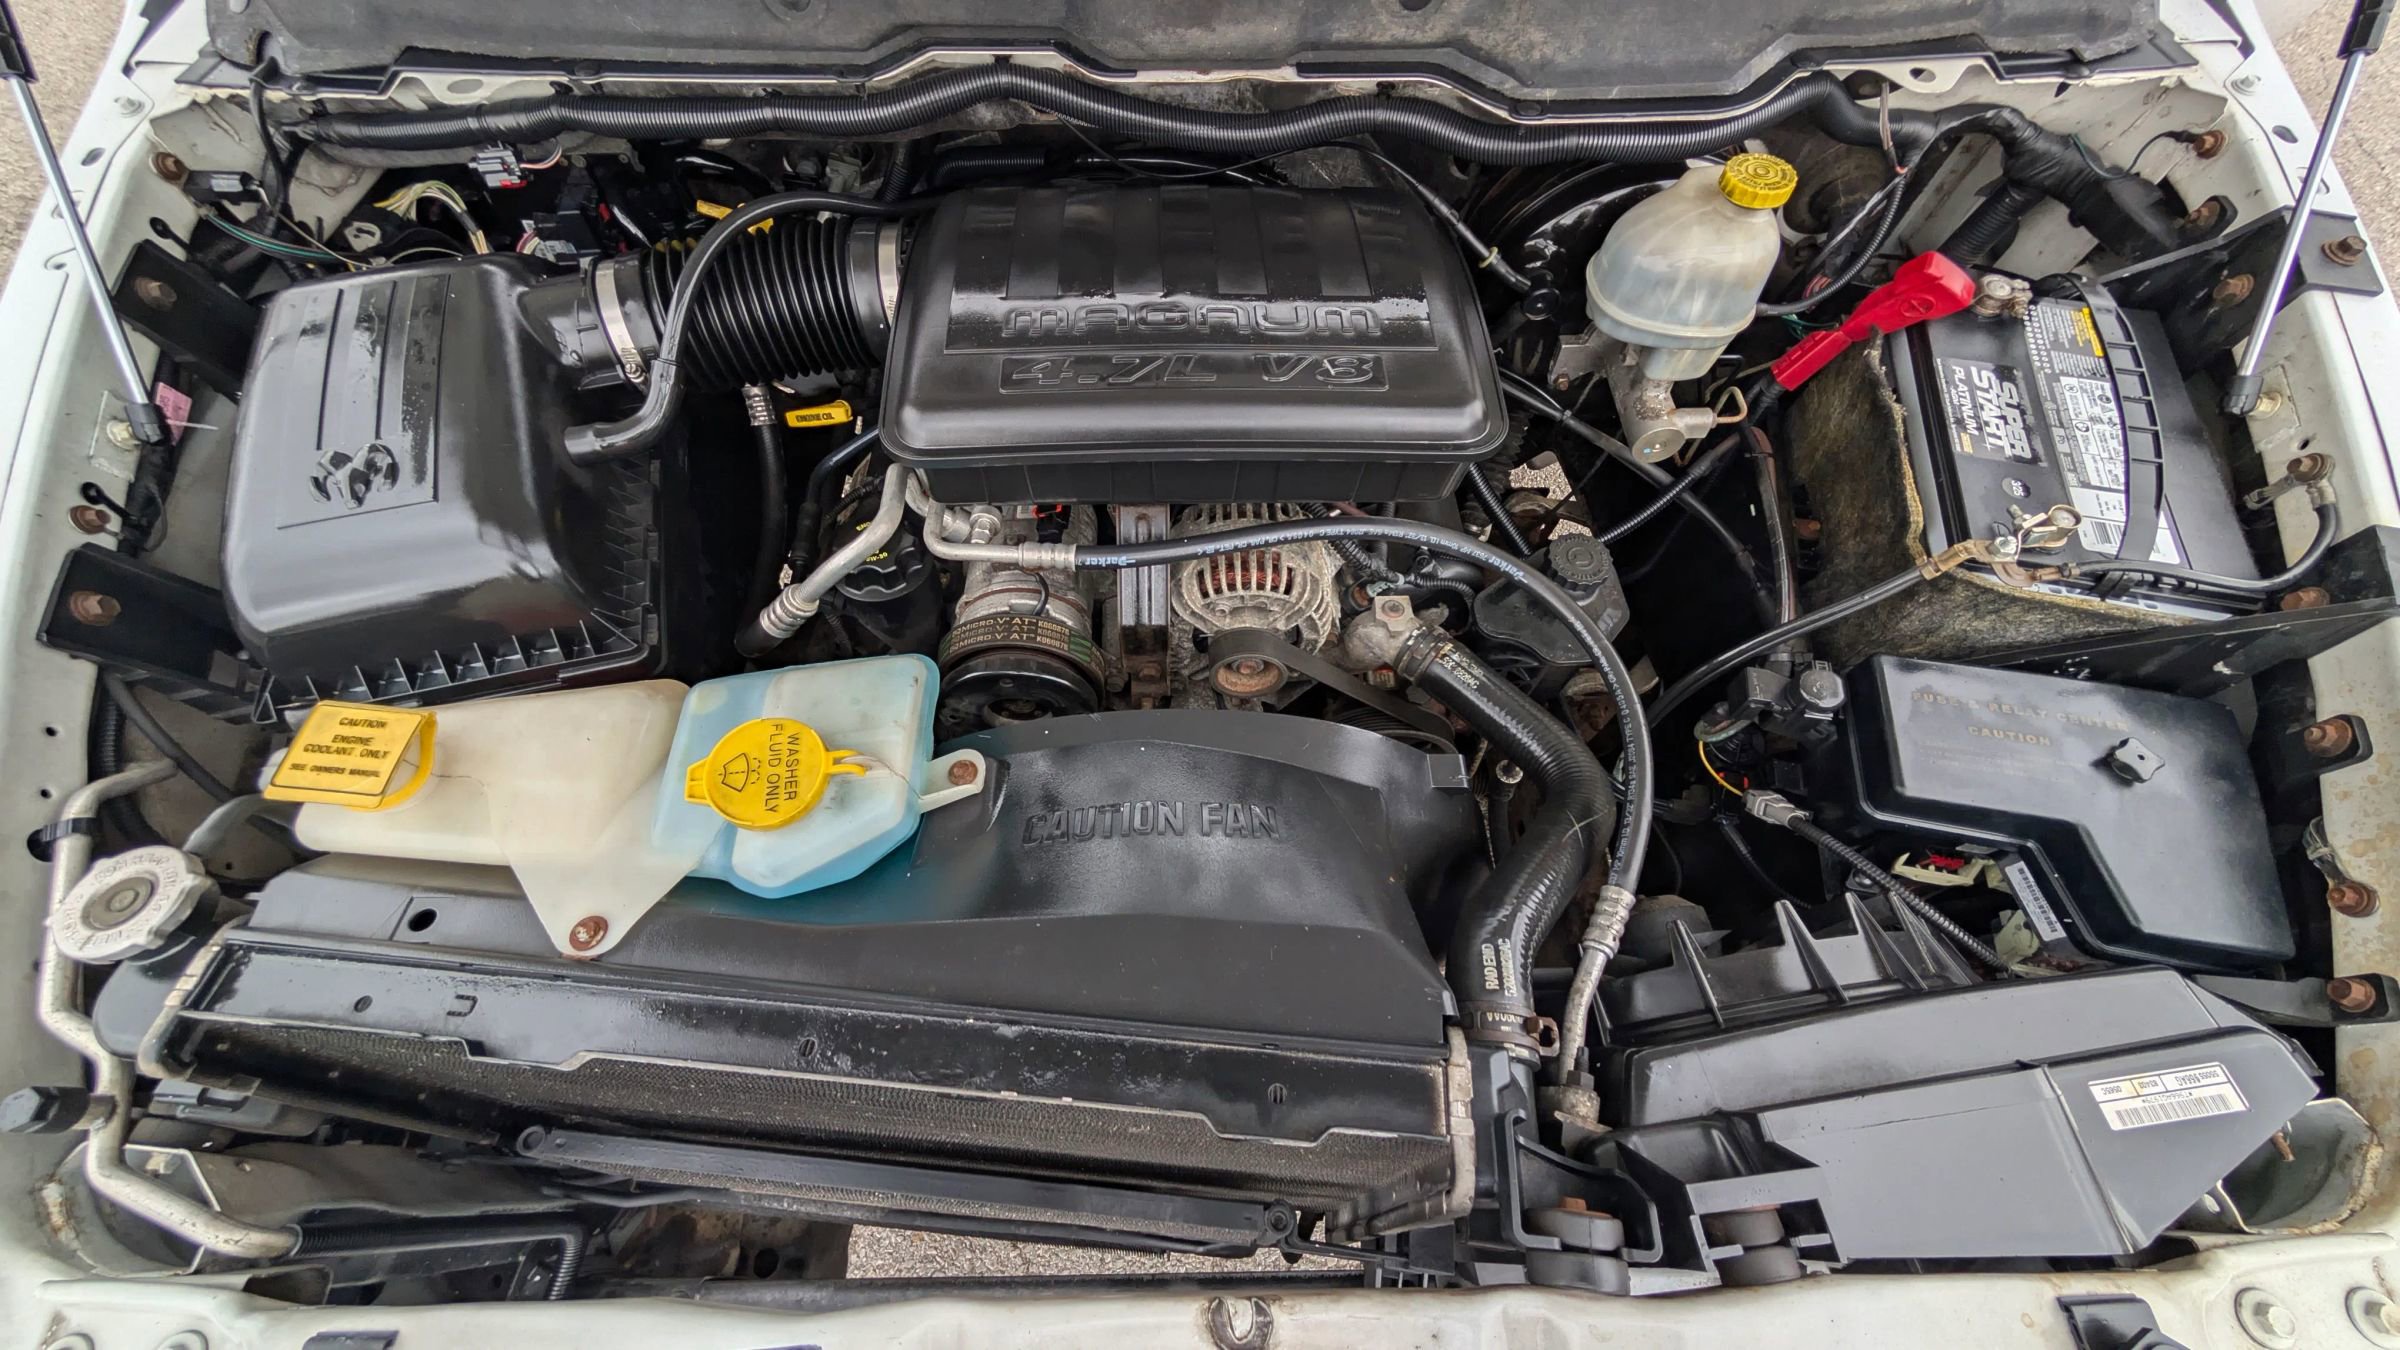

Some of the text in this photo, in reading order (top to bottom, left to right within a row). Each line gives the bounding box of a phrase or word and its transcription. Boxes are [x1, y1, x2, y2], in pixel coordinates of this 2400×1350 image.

[1003, 303, 1382, 337] MAGNUM
[1012, 355, 1374, 385] 4.7L V8
[1952, 366, 1979, 436] PLATINUM
[1970, 366, 2012, 458] START
[1998, 382, 2032, 459] SUPER
[1084, 554, 1132, 567] Parker
[1488, 556, 1528, 583] Parker
[339, 717, 388, 728] CAUTION
[1912, 691, 1958, 706] FUSE
[1988, 702, 2049, 719] RELAY
[2057, 712, 2129, 732] CENTER
[331, 734, 375, 746] ENGINE
[1624, 722, 1633, 742] TYPE
[1968, 725, 2050, 746] CAUTION
[303, 744, 391, 759] COOLANT ONLY
[784, 732, 800, 801] WASHER
[289, 763, 306, 772] SEE
[348, 768, 380, 778] MANUAL
[764, 723, 783, 813] FLUID ONLY
[1021, 800, 1281, 847] CAUTION FAN
[1481, 943, 1499, 990] RAD END
